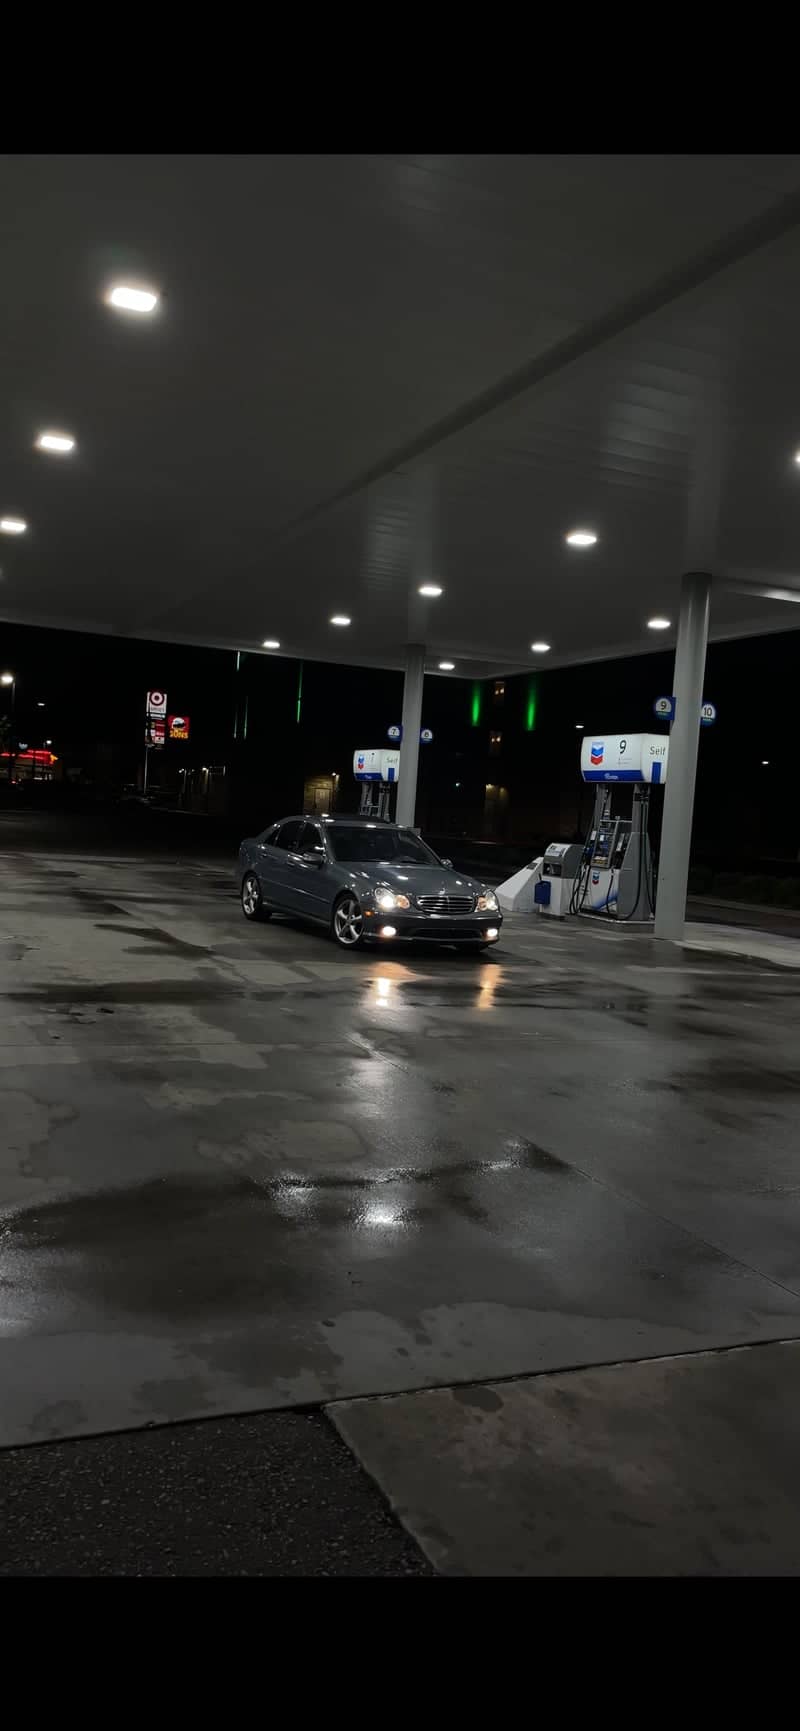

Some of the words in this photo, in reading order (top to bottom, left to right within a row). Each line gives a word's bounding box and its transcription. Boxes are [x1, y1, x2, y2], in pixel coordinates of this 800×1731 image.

[660, 701, 667, 711] 9
[703, 707, 713, 717] 10
[619, 739, 627, 754] 9
[650, 745, 666, 756] Self
